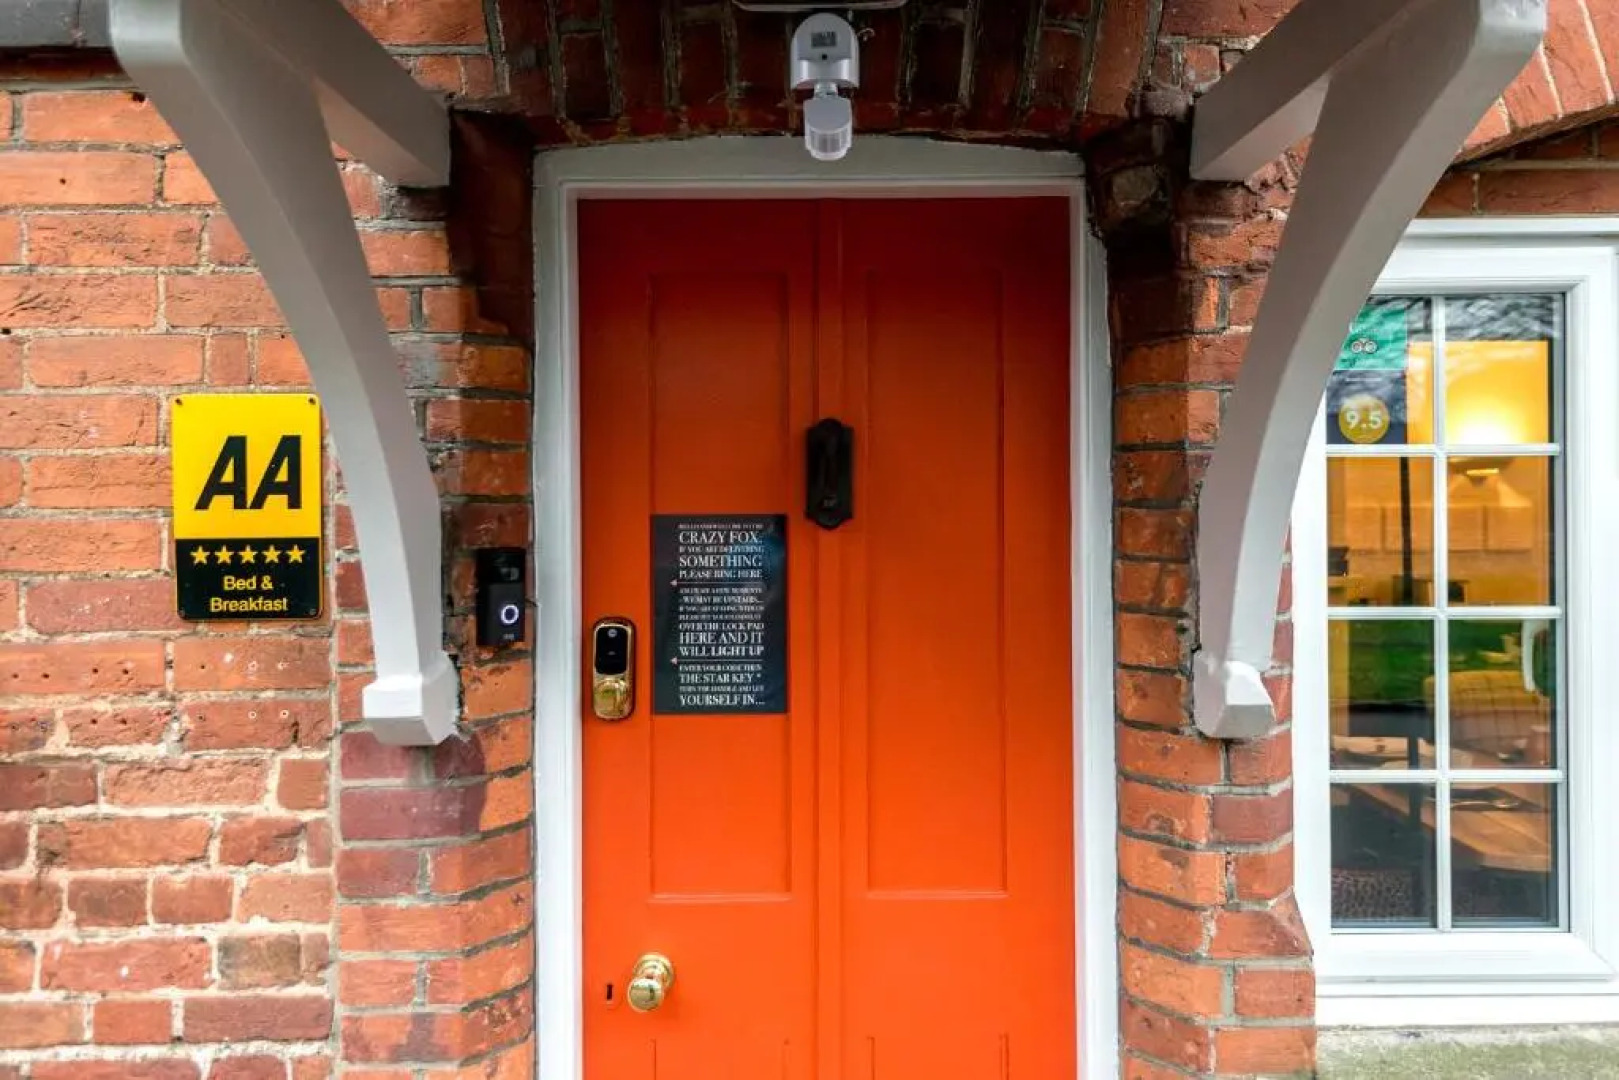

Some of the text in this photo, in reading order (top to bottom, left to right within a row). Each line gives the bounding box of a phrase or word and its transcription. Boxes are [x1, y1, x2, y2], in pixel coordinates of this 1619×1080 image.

[1346, 409, 1382, 429] 9.5
[194, 435, 302, 510] AA
[679, 531, 726, 544] CRAZY
[679, 555, 762, 567] SOMETHING
[680, 569, 762, 578] PLEASE RING HERE
[223, 575, 274, 590] Bed &
[210, 597, 288, 612] Breakfast
[721, 622, 746, 631] LOCK
[747, 622, 764, 631] PAD
[679, 632, 764, 644] HERE AND IT
[679, 645, 764, 656] WILL LIGHT UP
[680, 673, 754, 683] THE STAR KEY
[679, 693, 741, 706] YOURSELF
